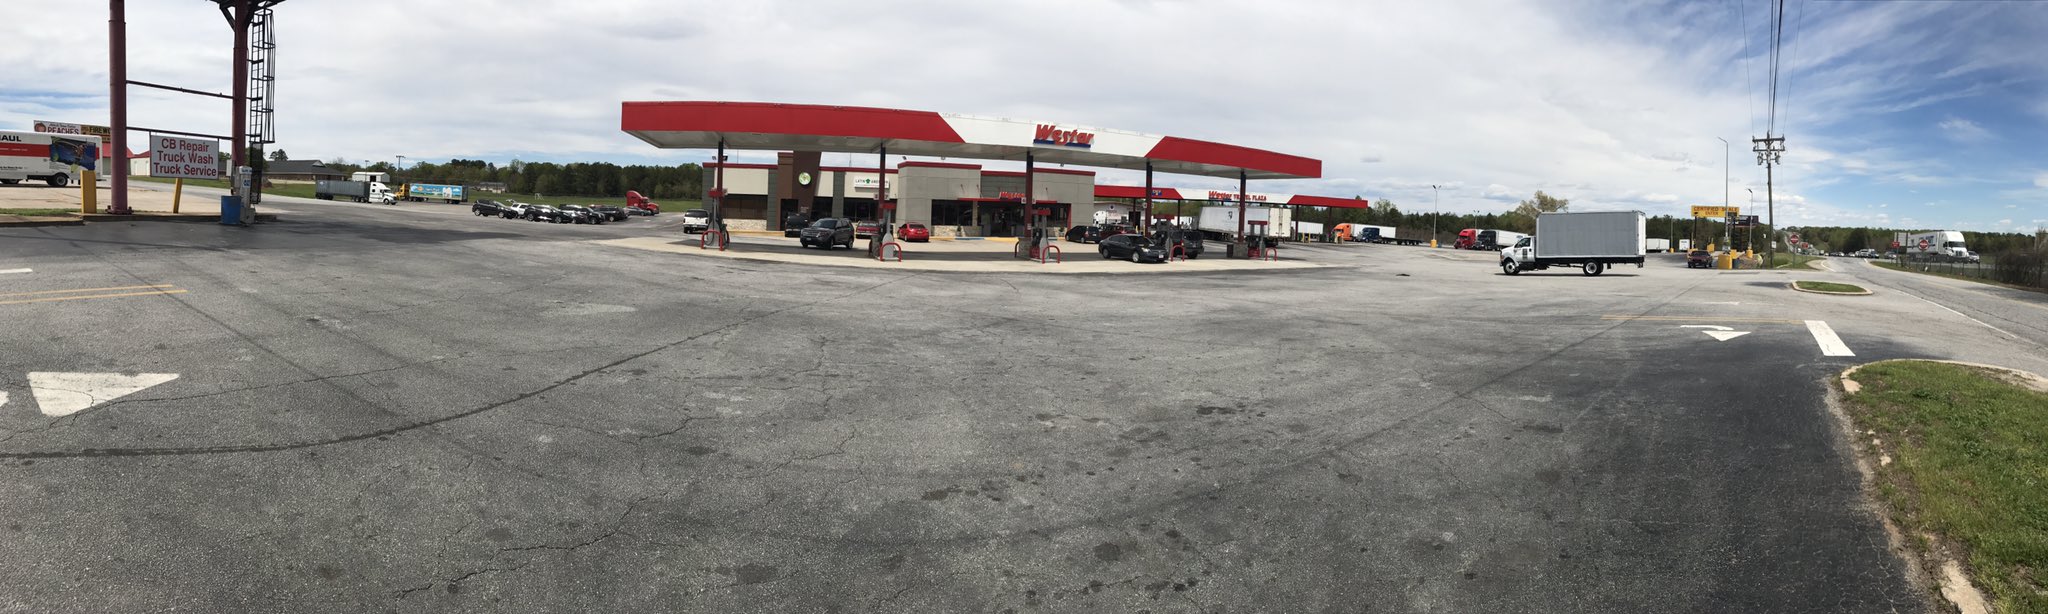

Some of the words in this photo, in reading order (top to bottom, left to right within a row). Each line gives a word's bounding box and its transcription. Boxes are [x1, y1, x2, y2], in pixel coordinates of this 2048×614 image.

[47, 126, 79, 135] PEACHES
[1035, 124, 1094, 146] Westar
[0, 134, 22, 142] AUL
[161, 138, 176, 149] CB
[179, 140, 209, 153] Repair
[157, 150, 185, 163] Truck
[188, 153, 213, 164] Wash
[153, 162, 181, 175] Truck
[183, 164, 216, 177] Service
[1208, 190, 1232, 200] Westar
